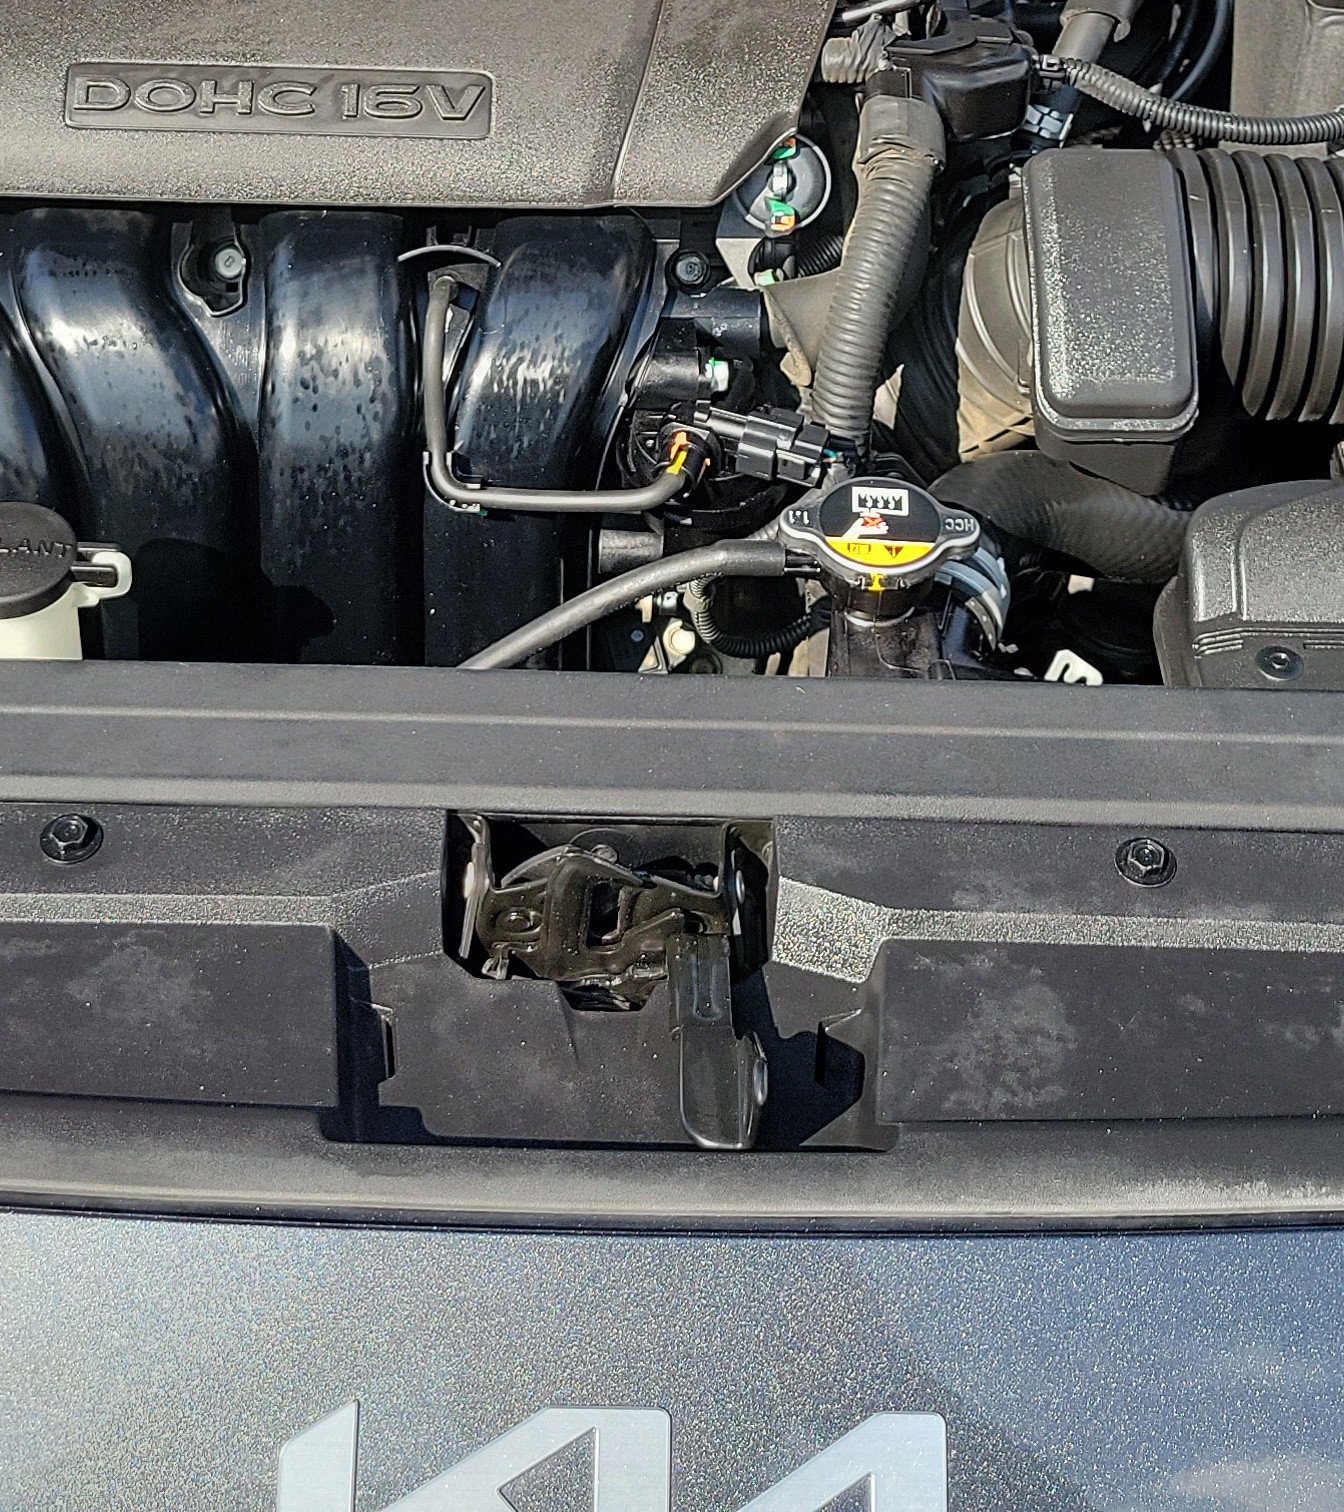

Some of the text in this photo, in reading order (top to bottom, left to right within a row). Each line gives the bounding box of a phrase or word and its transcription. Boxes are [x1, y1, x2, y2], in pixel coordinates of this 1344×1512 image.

[72, 76, 485, 122] DOHC 16V
[943, 517, 976, 531] HCC
